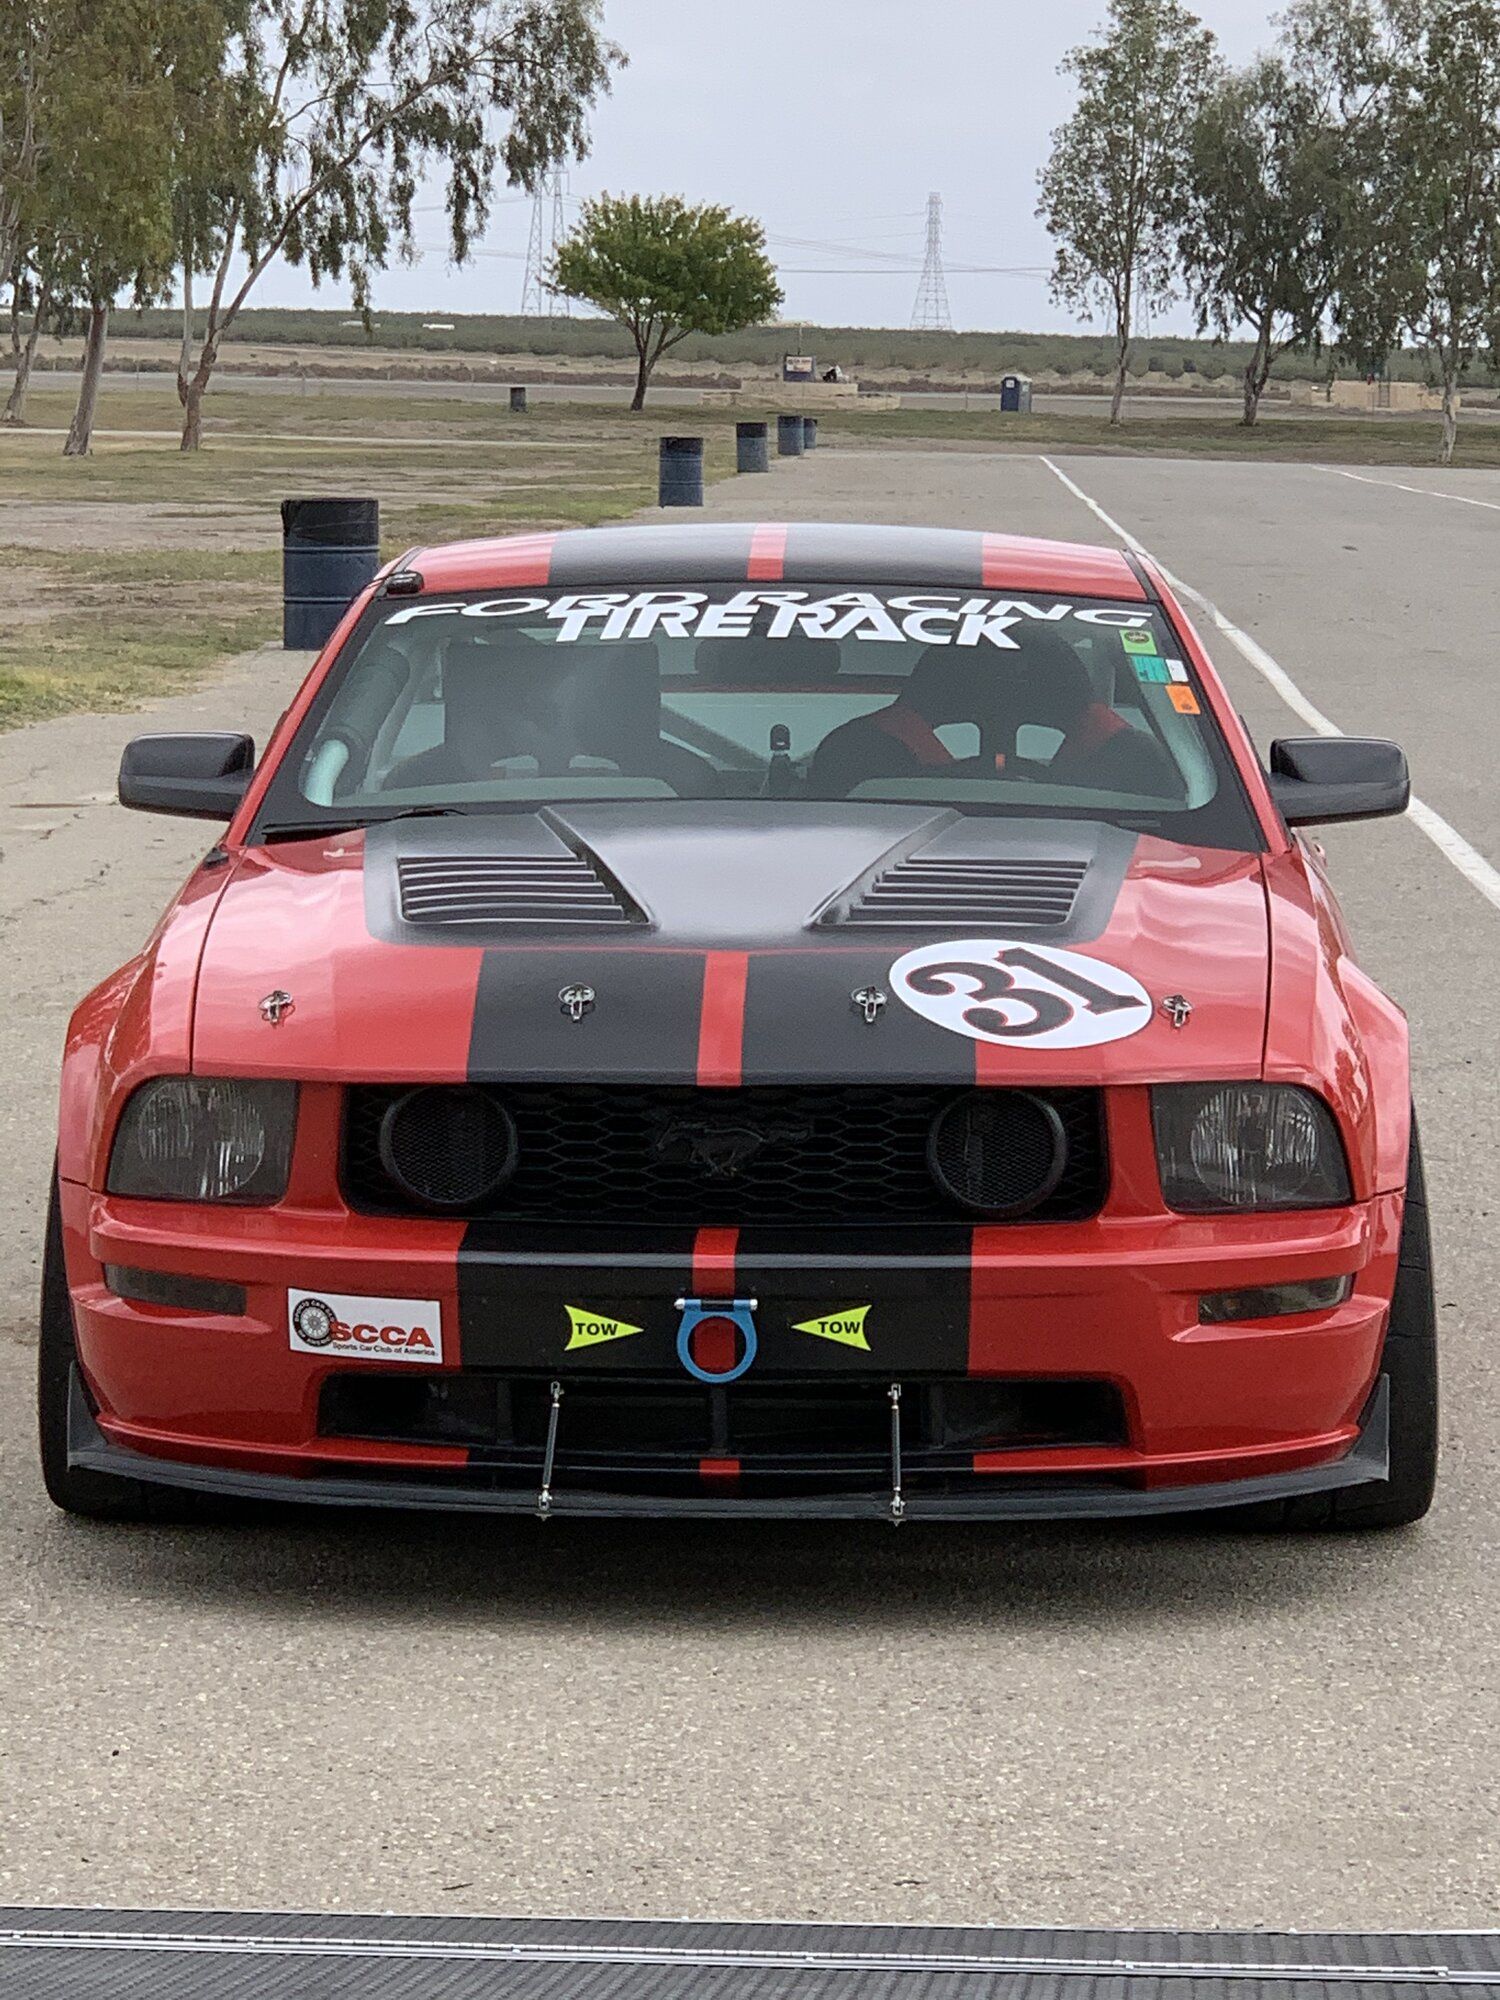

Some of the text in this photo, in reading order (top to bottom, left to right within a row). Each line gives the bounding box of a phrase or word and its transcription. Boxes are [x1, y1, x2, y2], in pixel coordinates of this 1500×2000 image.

[384, 590, 1152, 627] FORD RACING
[905, 946, 1148, 1037] 31
[330, 1321, 435, 1348] SCCA
[575, 1321, 618, 1336] TOW
[817, 1320, 861, 1335] TOW
[332, 1341, 358, 1351] Sports
[359, 1344, 372, 1352] Car
[373, 1345, 393, 1353] Club
